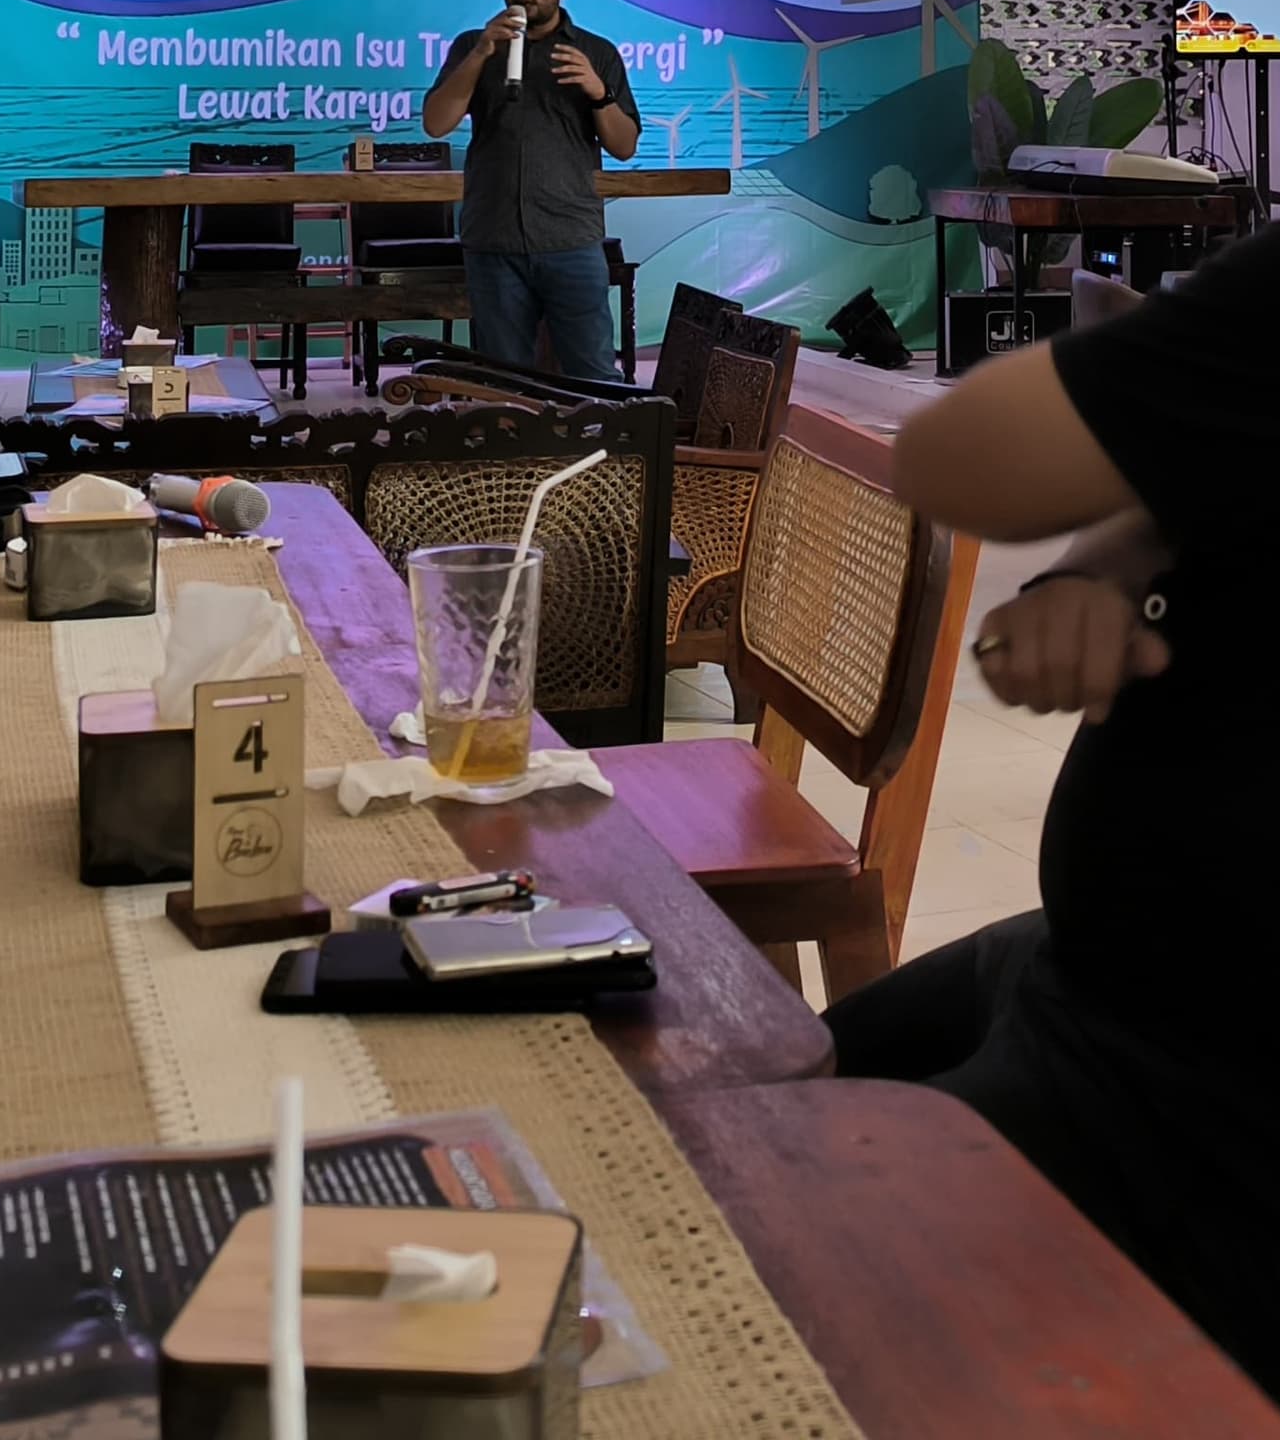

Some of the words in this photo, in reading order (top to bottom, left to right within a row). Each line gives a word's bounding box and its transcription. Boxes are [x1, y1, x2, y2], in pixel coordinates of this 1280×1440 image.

[97, 27, 342, 68] Membumikan
[355, 32, 406, 69] Isu
[618, 32, 687, 82] ergi
[177, 81, 291, 121] Lewat
[304, 84, 412, 133] Karya
[233, 720, 269, 775] 4
